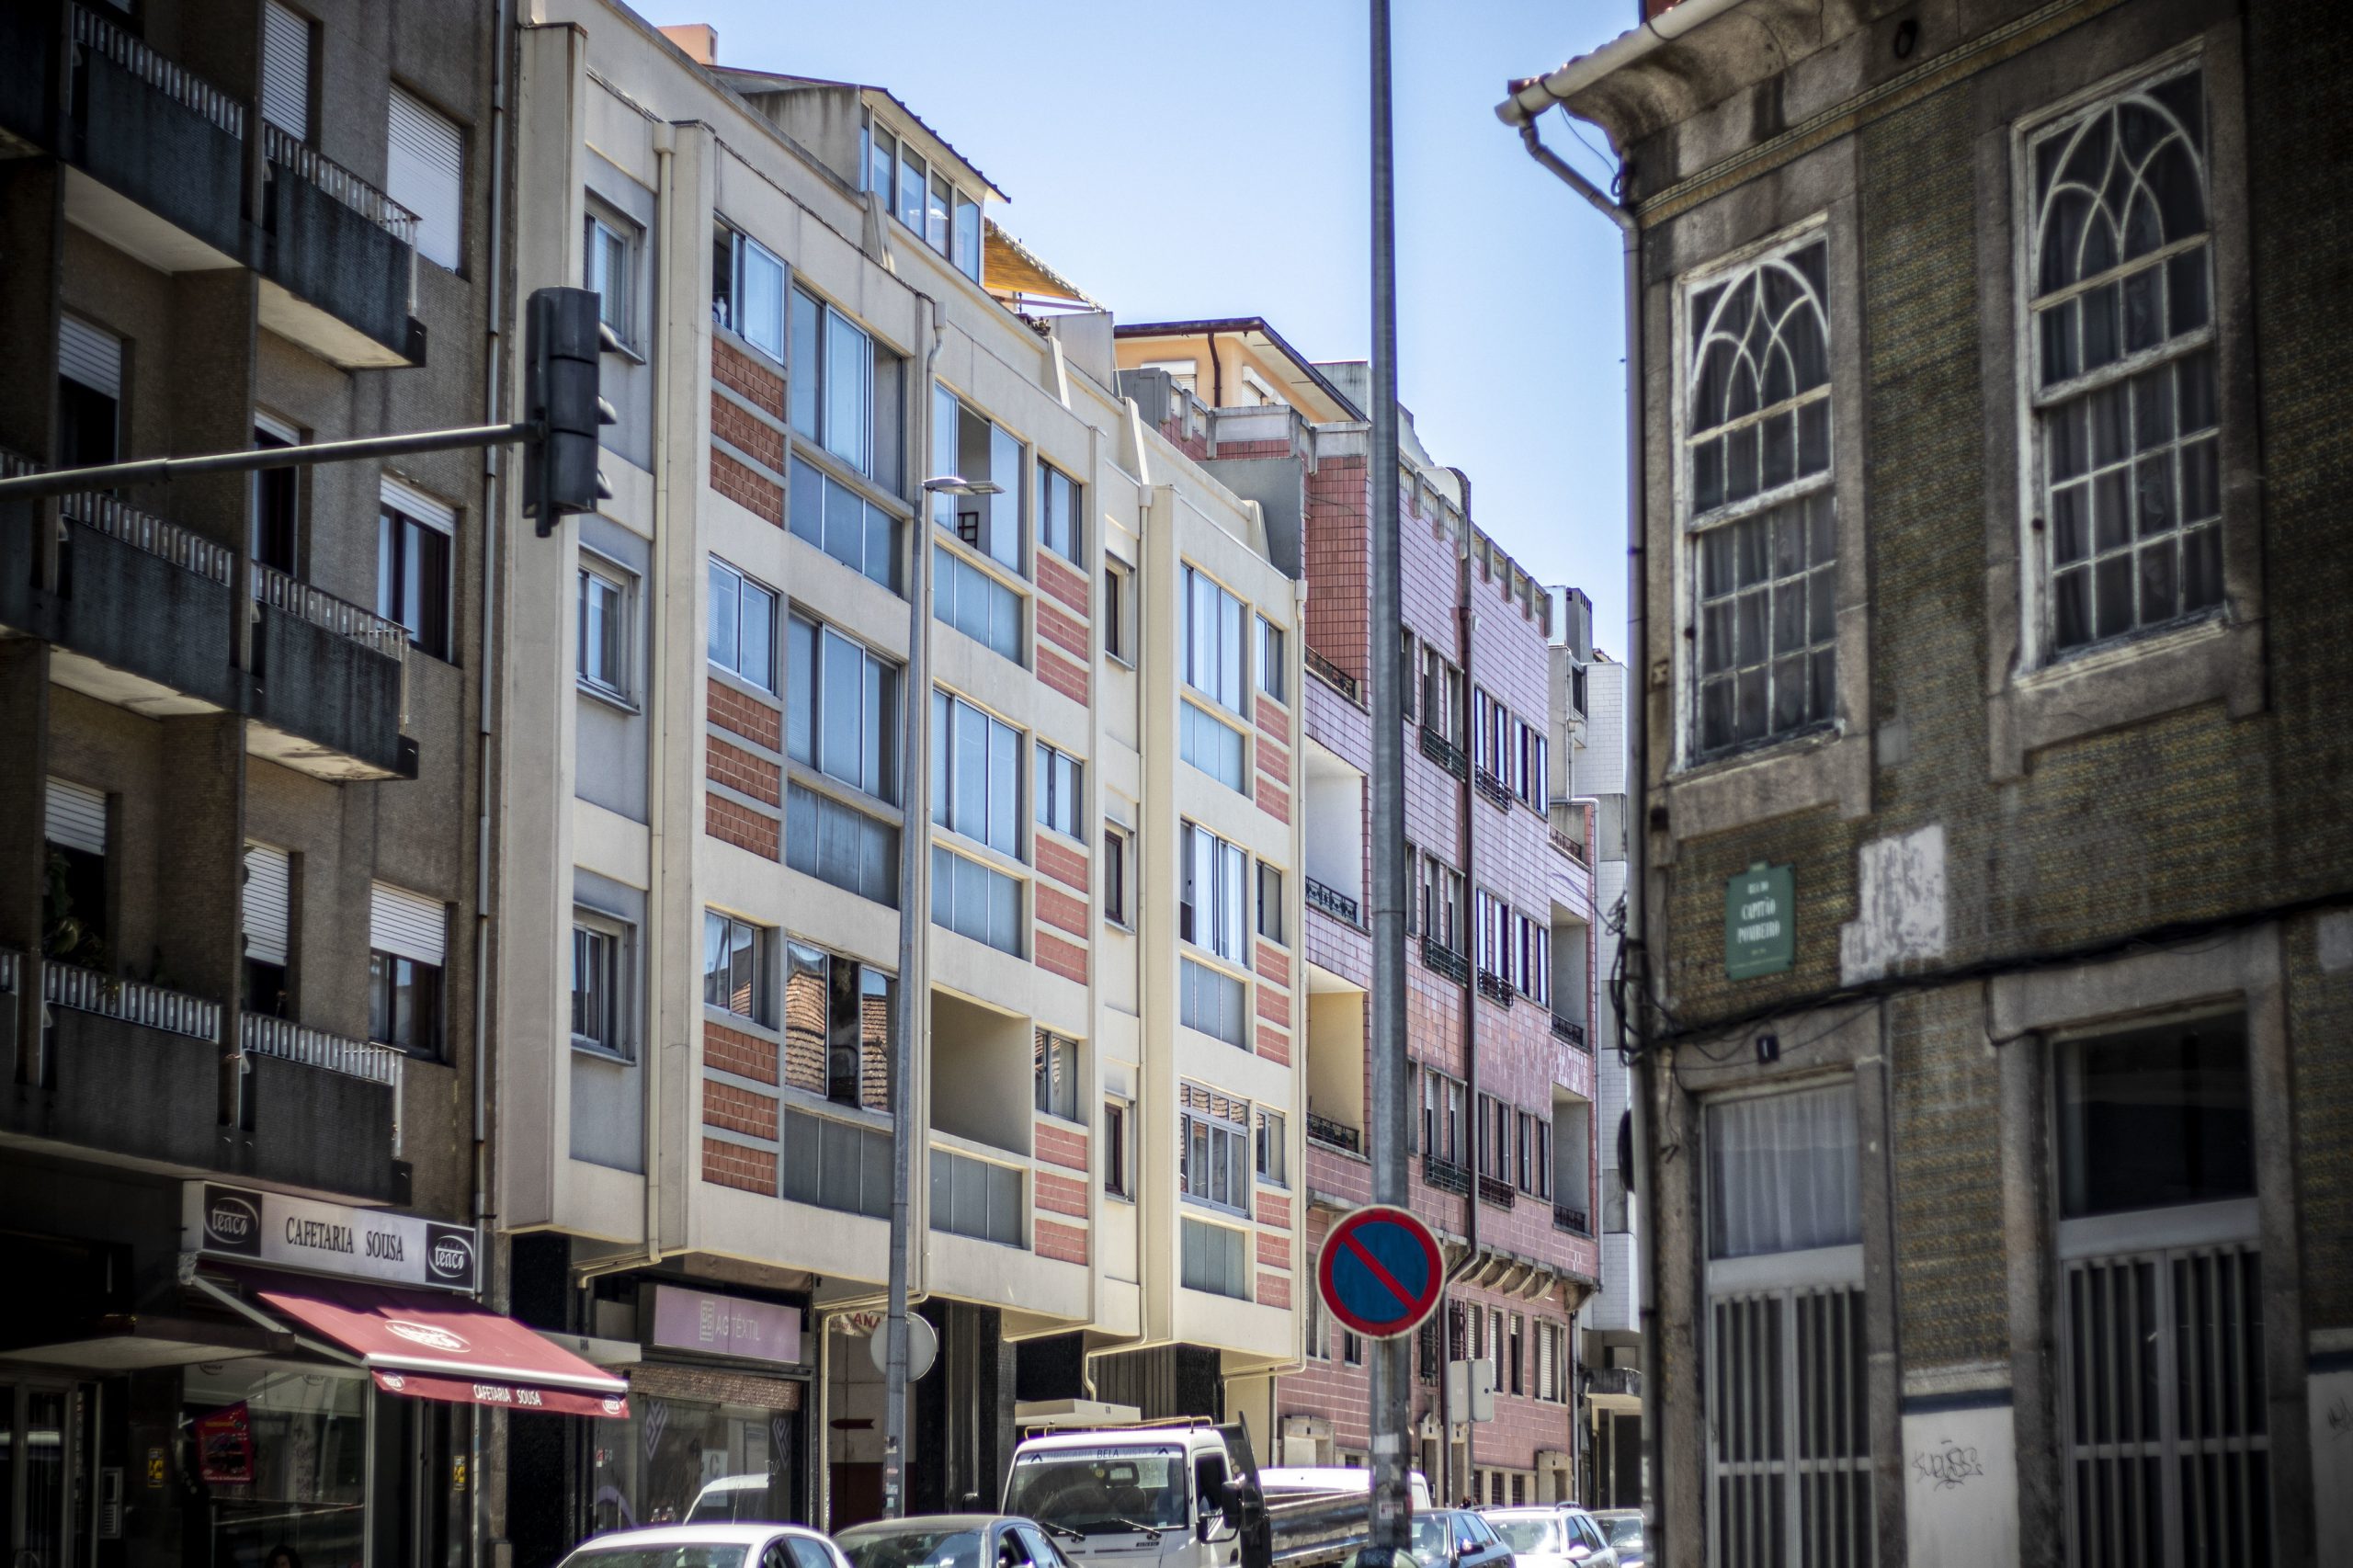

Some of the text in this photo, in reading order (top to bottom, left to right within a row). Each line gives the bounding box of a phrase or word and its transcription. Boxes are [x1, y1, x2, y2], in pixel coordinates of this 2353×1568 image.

[1741, 896, 1776, 920] CAPITÃO
[286, 1217, 404, 1262] CAFETARIA SOUSA
[715, 1314, 730, 1336] AG
[472, 1383, 542, 1406] CAFETARIA SOUSA
[1097, 1449, 1120, 1460] BELA
